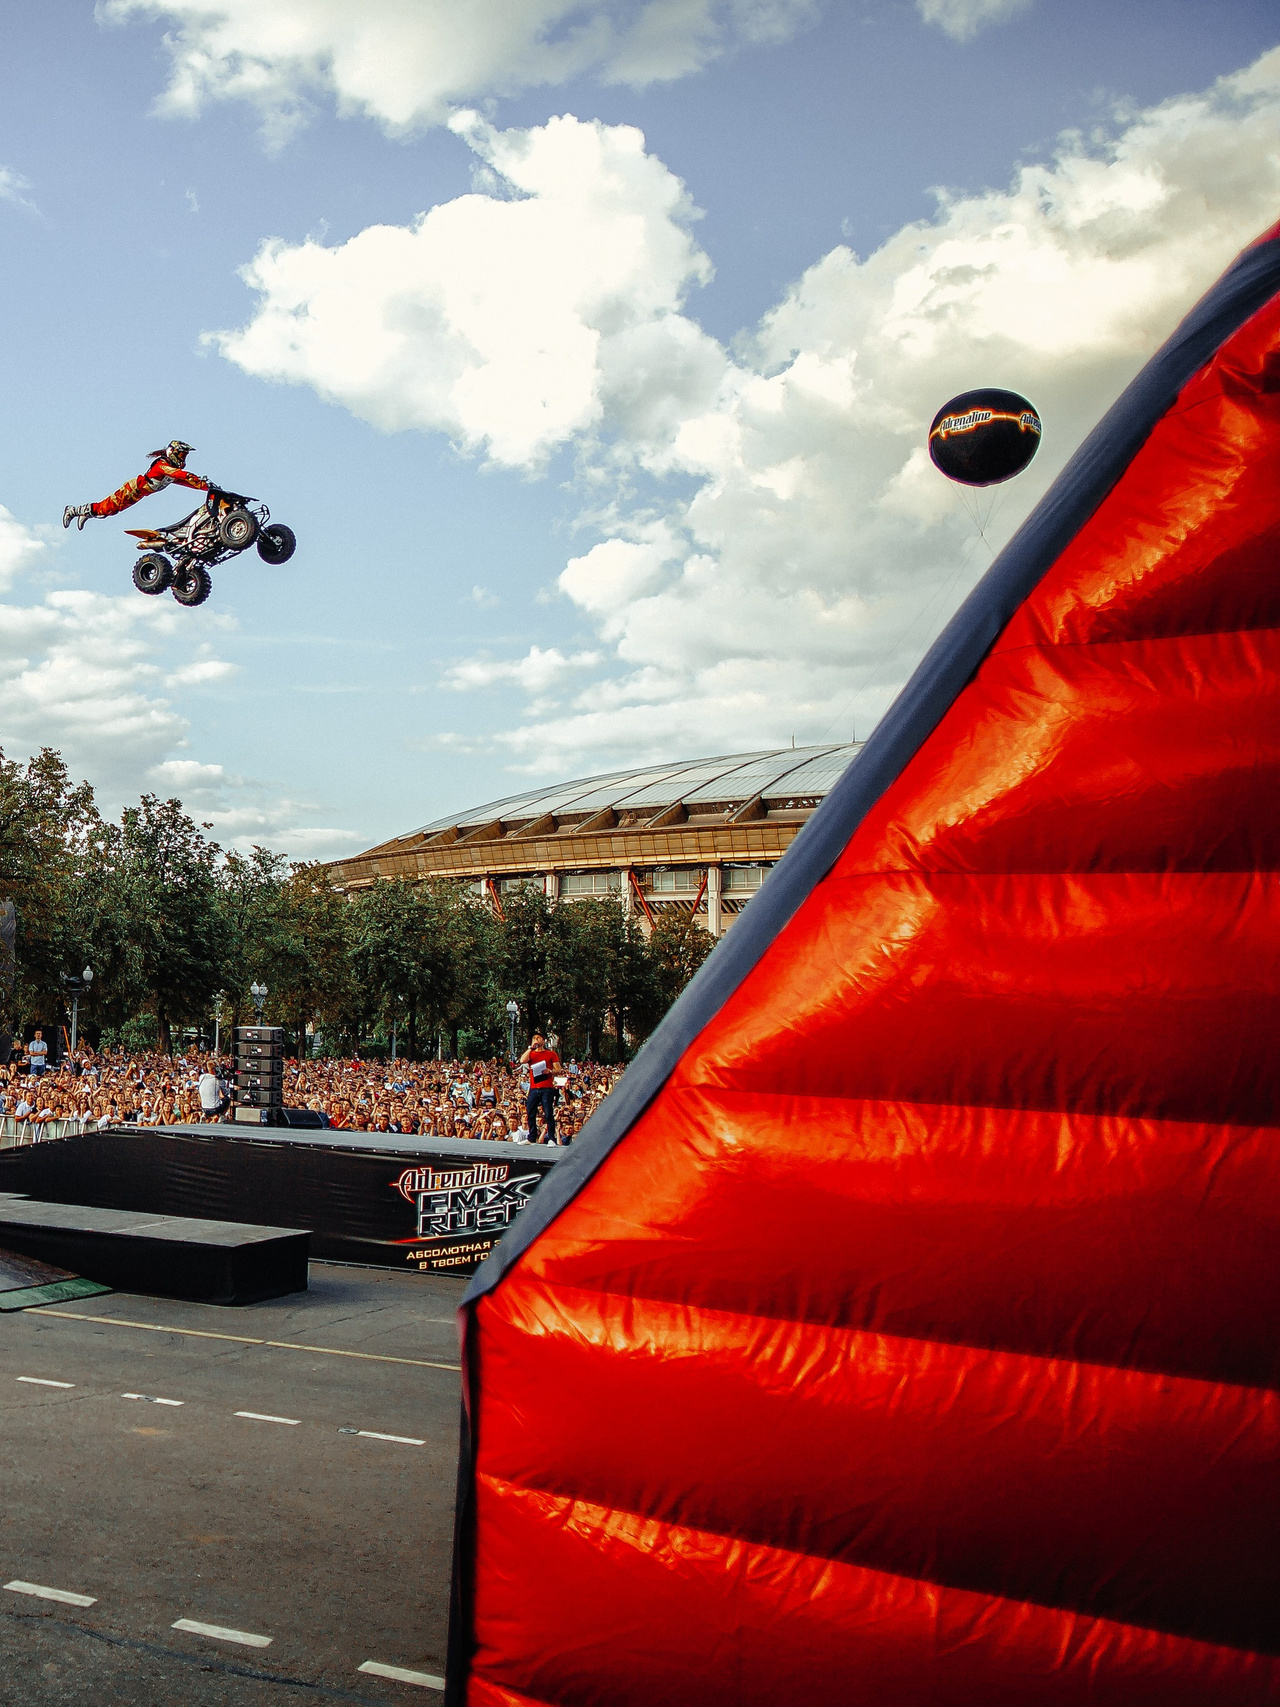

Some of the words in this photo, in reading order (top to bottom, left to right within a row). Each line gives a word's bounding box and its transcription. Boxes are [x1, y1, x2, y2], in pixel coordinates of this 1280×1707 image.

[940, 410, 991, 436] Adrenaline
[389, 1163, 508, 1204] Adrenaline
[419, 1173, 541, 1213] FMX
[406, 1241, 491, 1260] АБСОЛЮТНАЯ
[419, 1262, 428, 1270] В
[431, 1255, 471, 1268] ТВОЕМ
[474, 1252, 492, 1262] ГО
